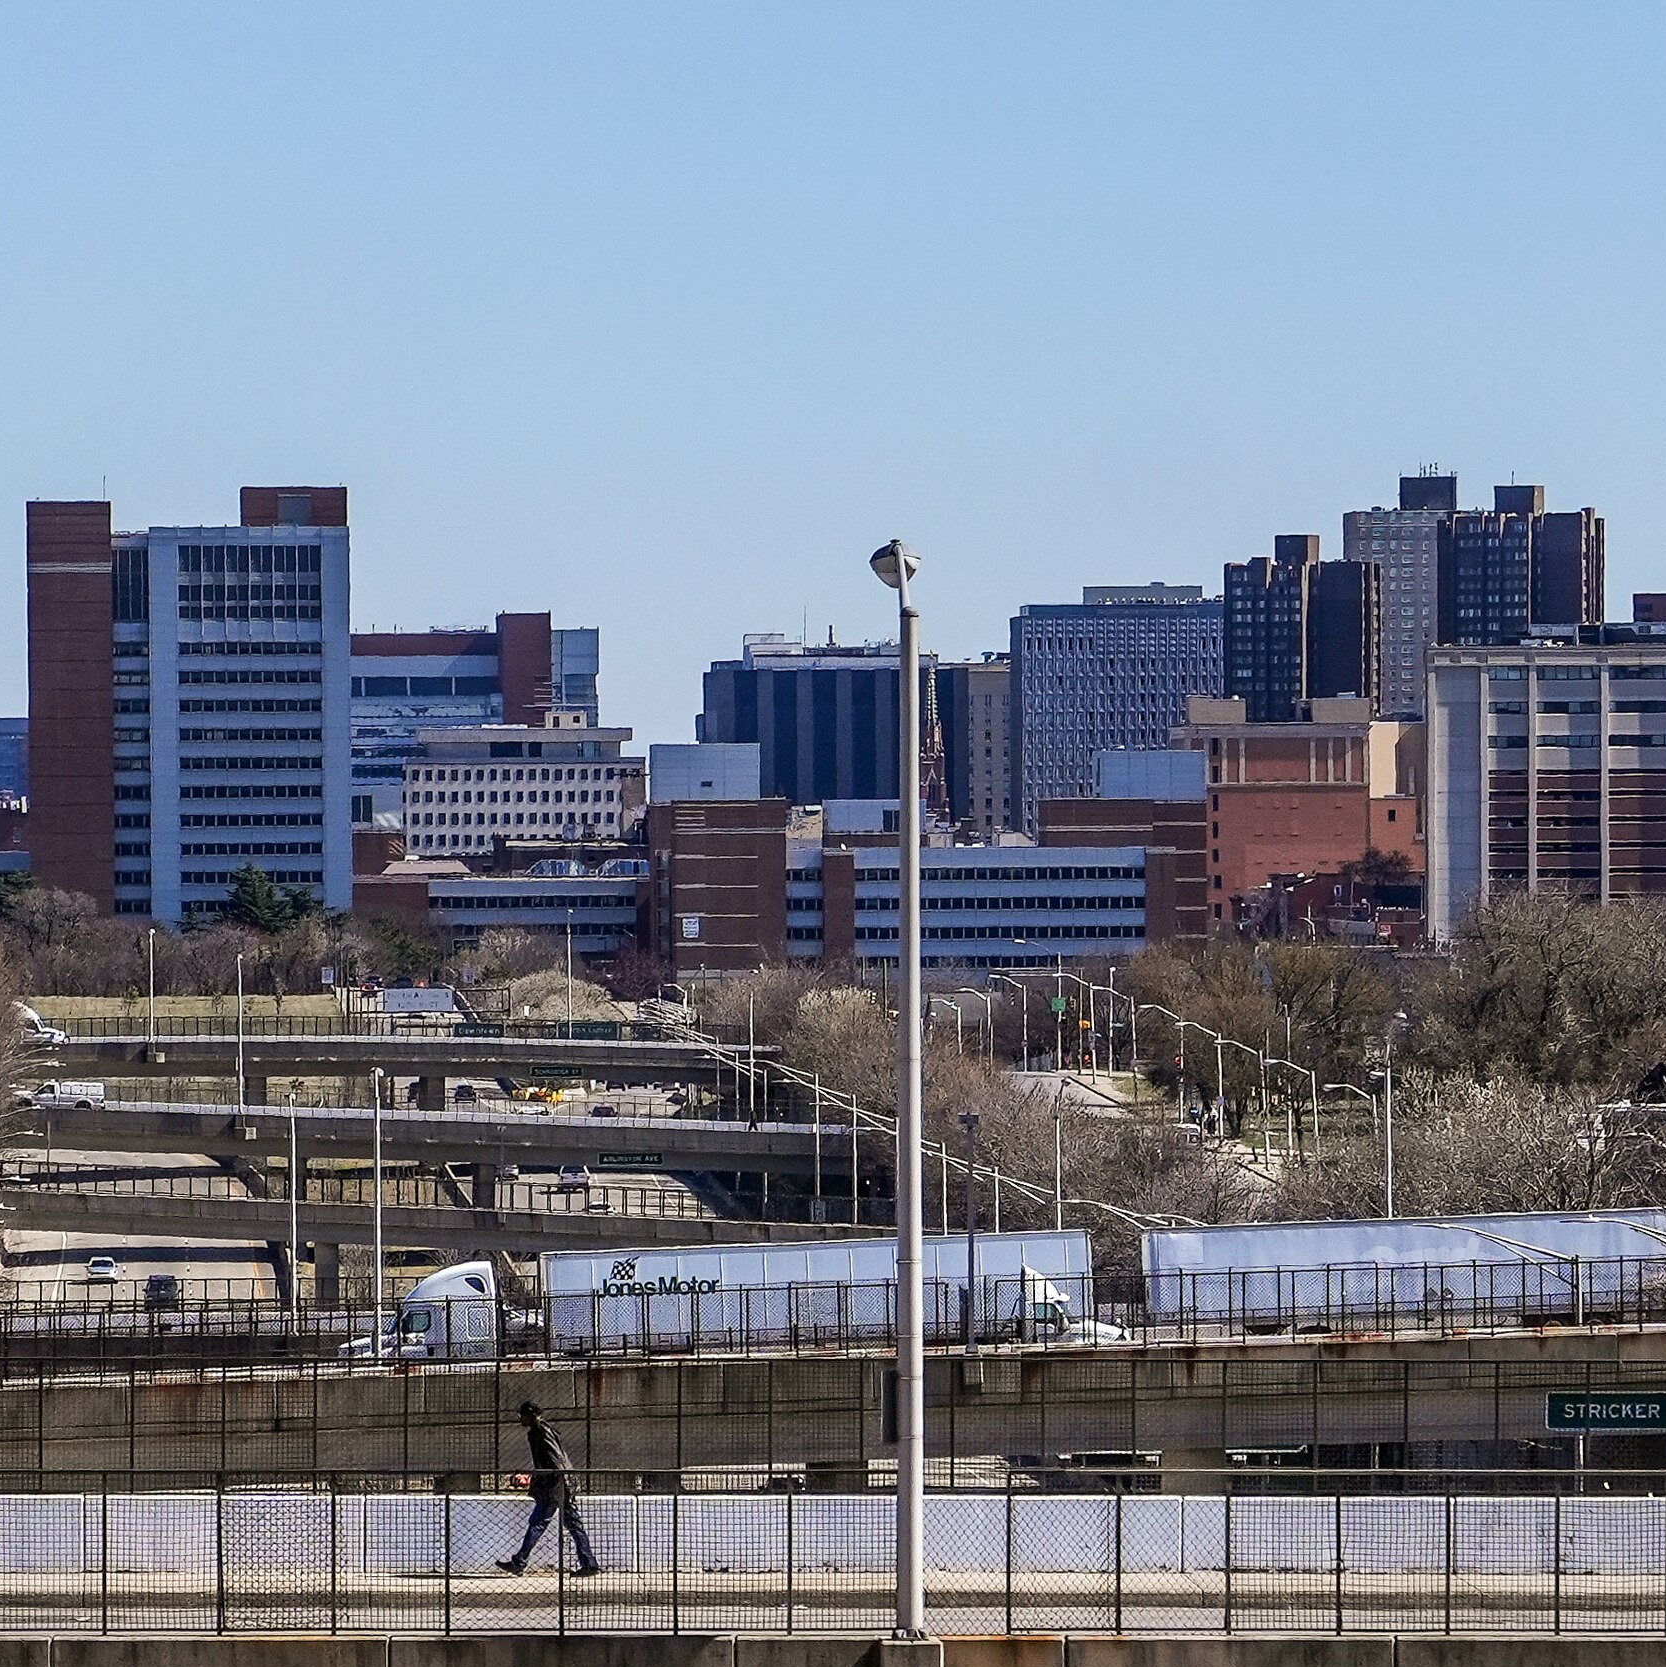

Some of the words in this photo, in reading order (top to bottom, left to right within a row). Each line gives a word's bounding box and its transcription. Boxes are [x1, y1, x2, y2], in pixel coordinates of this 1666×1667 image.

[602, 1278, 657, 1297] Jones
[658, 1275, 720, 1296] Motor
[1563, 1403, 1661, 1419] STRICKER
